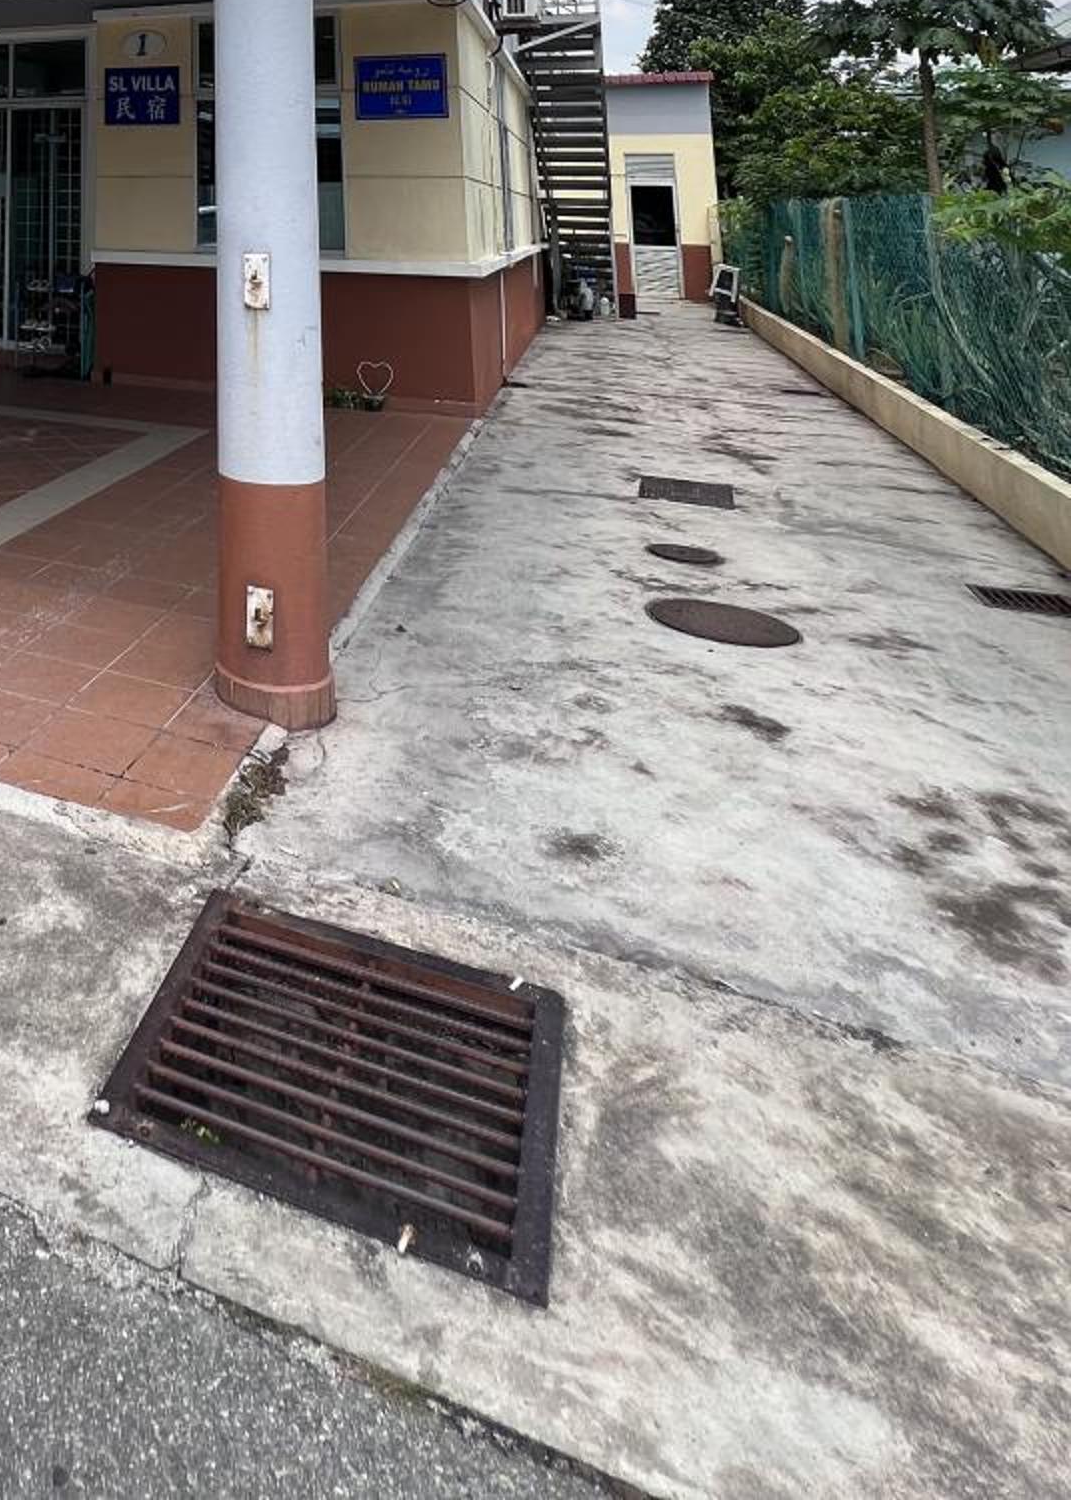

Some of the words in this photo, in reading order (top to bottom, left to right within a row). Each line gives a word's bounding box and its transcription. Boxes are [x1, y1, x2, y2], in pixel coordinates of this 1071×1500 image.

[136, 33, 147, 57] 1
[108, 75, 128, 93] SL
[131, 74, 176, 92] VILLA
[116, 95, 167, 121] 民宿
